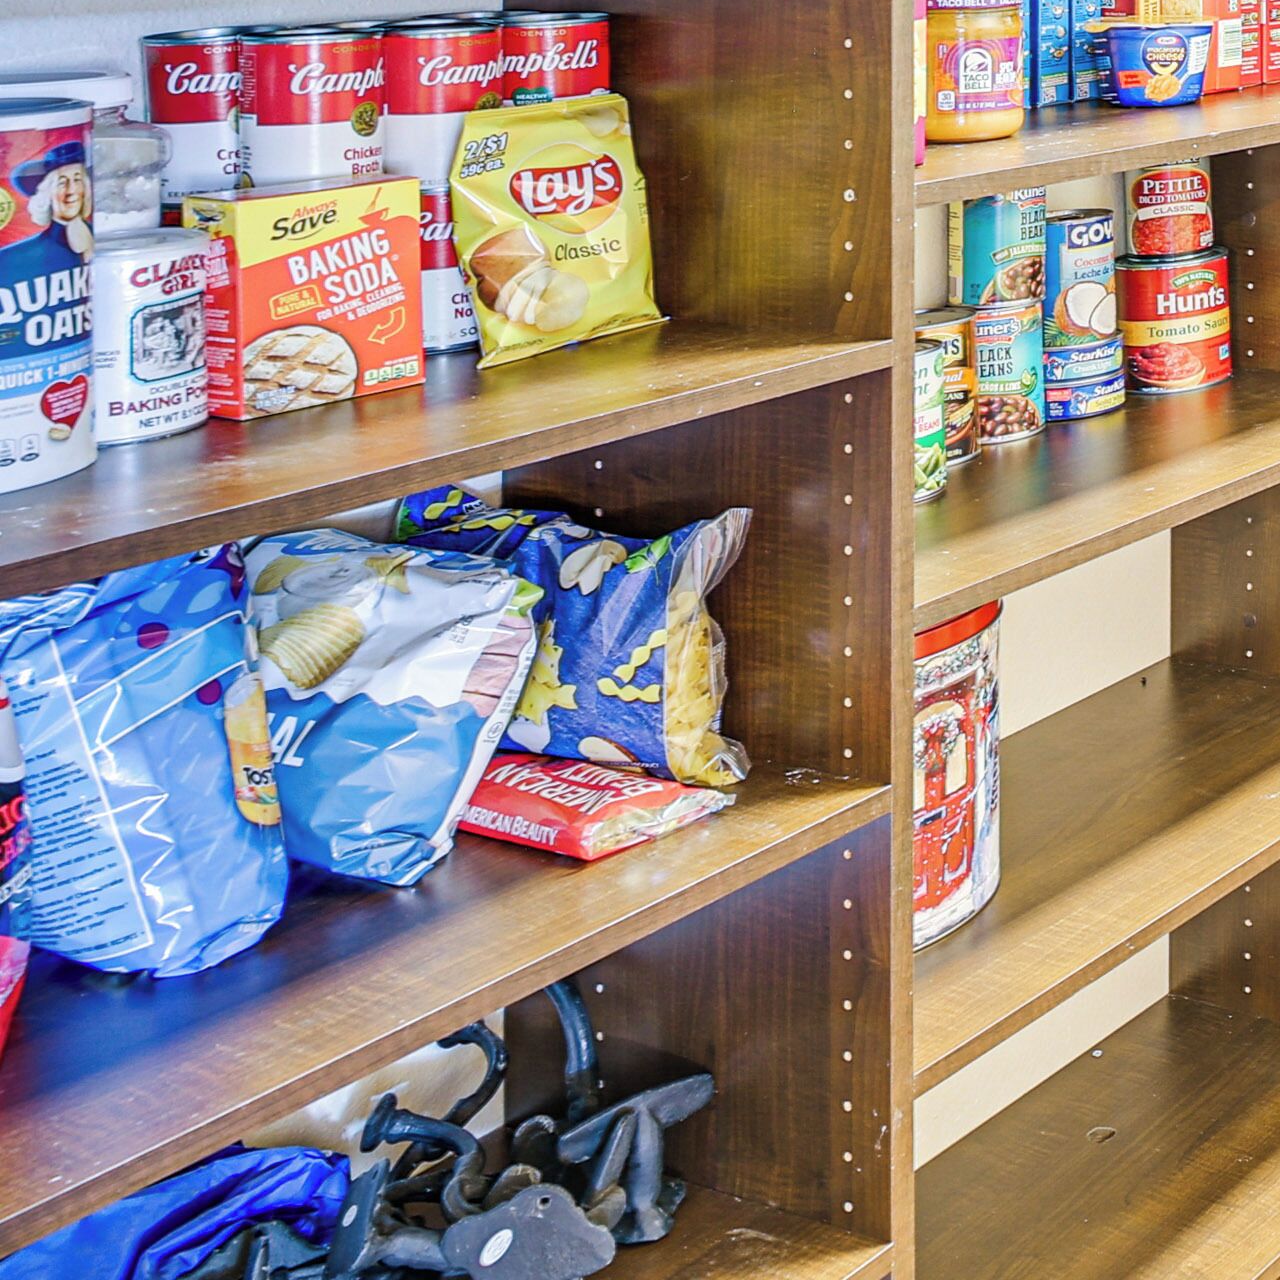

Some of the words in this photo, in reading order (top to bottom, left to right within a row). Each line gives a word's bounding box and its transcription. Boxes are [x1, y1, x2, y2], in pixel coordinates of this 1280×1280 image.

[936, 0, 963, 7] TACO
[962, 74, 989, 82] TACO
[964, 82, 990, 90] BELL
[521, 160, 620, 216] Lay's
[1142, 176, 1203, 195] PETITE
[1139, 193, 1164, 204] DICED
[1166, 190, 1206, 203] TOMATOES
[292, 199, 338, 220] Always
[1152, 205, 1195, 215] CLASSIC
[271, 208, 337, 241] Save
[1070, 220, 1113, 246] GOY
[288, 229, 391, 286] BAKING
[555, 237, 622, 262] Classic
[323, 256, 398, 304] SODA
[1074, 269, 1101, 280] Leche
[276, 298, 317, 316] NATURAL
[278, 292, 300, 305] PURE
[1156, 286, 1226, 315] Hunt's
[316, 310, 333, 321] FOR
[347, 311, 356, 321] &
[976, 319, 1019, 336] uner's
[1146, 322, 1200, 338] Tomato
[1203, 316, 1228, 330] Sauc
[978, 347, 1013, 363] LACK
[979, 362, 1014, 378] EANS
[150, 379, 189, 395] DOUBLE
[108, 392, 183, 417] BAKING
[139, 415, 161, 429] NET
[163, 412, 179, 425] WT
[514, 815, 559, 846] BEAUTY
